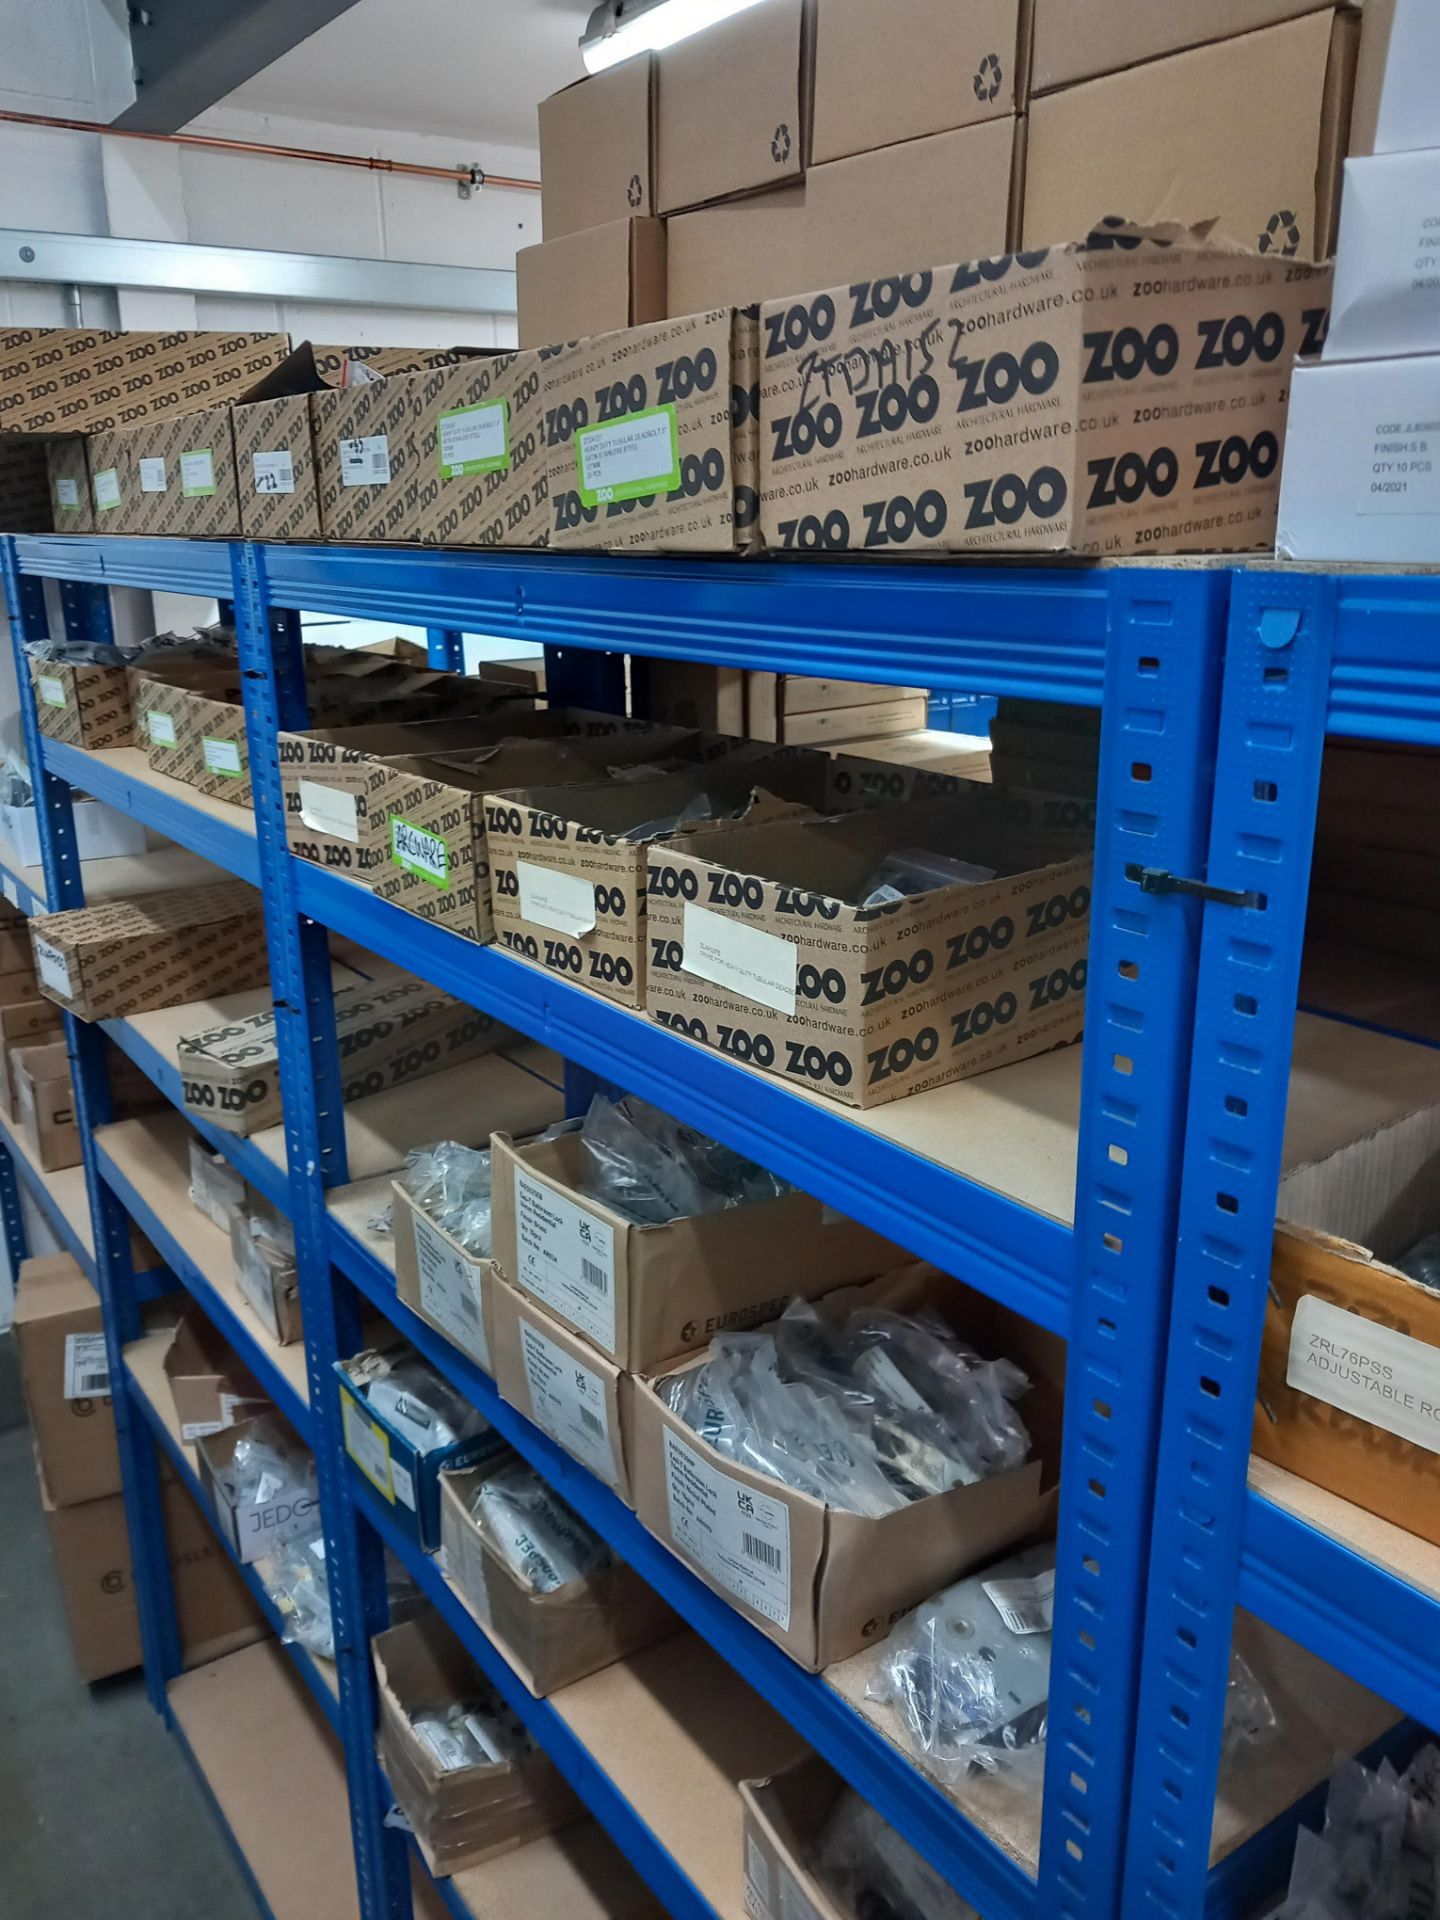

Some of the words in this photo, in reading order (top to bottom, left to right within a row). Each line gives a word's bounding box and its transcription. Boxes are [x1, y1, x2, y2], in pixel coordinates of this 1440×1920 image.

[764, 293, 836, 359] ZOO
[849, 270, 934, 329] ZOO
[1, 330, 33, 350] ZOO
[32, 348, 64, 369] ZOO
[66, 336, 97, 356] ZOO
[1082, 323, 1179, 384] ZOO
[1194, 311, 1285, 370] ZOO
[24, 411, 56, 431] ZOO
[58, 398, 89, 419] ZOO
[90, 386, 121, 406] ZOO
[155, 361, 185, 381] ZOO
[187, 349, 216, 369] ZOO
[218, 336, 248, 357] ZOO
[27, 380, 58, 401] ZOO
[60, 367, 91, 388] ZOO
[181, 379, 211, 400] ZOO
[213, 367, 242, 387] ZOO
[244, 354, 272, 375] ZOO
[423, 371, 444, 407] ZOO
[467, 369, 490, 406] ZOO
[513, 371, 539, 413] ZOO
[354, 393, 370, 427] ZOO
[387, 397, 405, 431] ZOO
[545, 397, 588, 447] ZOO
[594, 373, 648, 423] ZOO
[655, 347, 718, 407] ZOO
[771, 401, 843, 462] ZOO
[855, 373, 941, 440] ZOO
[956, 340, 1060, 414] ZOO
[828, 445, 952, 487] zoohardware.co.uk
[1086, 447, 1180, 510] ZOO
[1193, 430, 1279, 490] ZOO
[459, 485, 482, 521] ZOO
[596, 487, 614, 502] ZOO
[1370, 481, 1407, 493] 04/2021
[353, 491, 370, 524] ZOO
[386, 499, 404, 532] ZOO
[437, 508, 458, 542] ZOO
[505, 493, 530, 531] ZOO
[552, 490, 599, 532] ZOO
[778, 509, 850, 549] ZOO
[863, 488, 948, 548] ZOO
[964, 465, 1068, 530] ZOO
[279, 742, 303, 763] ZOO
[308, 742, 336, 764] ZOO
[403, 789, 422, 810] ZOO
[441, 808, 460, 833] ZOO
[485, 806, 522, 836] ZOO
[528, 810, 568, 841] ZOO
[325, 846, 352, 869] ZOO
[458, 883, 477, 904] ZOO
[648, 865, 698, 901] ZOO
[708, 872, 764, 911] ZOO
[122, 950, 146, 968] ZOO
[503, 930, 539, 962] ZOO
[544, 939, 583, 974] ZOO
[589, 950, 634, 987] ZOO
[860, 948, 935, 1008] ZOO
[946, 915, 1015, 972] ZOO
[1025, 885, 1092, 938] ZOO
[117, 975, 140, 992] ZOO
[144, 961, 167, 978] ZOO
[692, 992, 778, 1021] zoohardware.co.uk
[867, 1026, 940, 1087] ZOO
[950, 991, 1018, 1049] ZOO
[1028, 957, 1089, 1012] ZOO
[389, 1040, 441, 1082] ZOO
[656, 1009, 708, 1043] ZOO
[716, 1024, 776, 1068] ZOO
[785, 1040, 853, 1087] ZOO
[182, 1081, 215, 1107] ZOO
[217, 1080, 269, 1112] ZOO
[1309, 1333, 1394, 1381] ZRL76PSS
[1306, 1351, 1415, 1410] ADJUSTABLE
